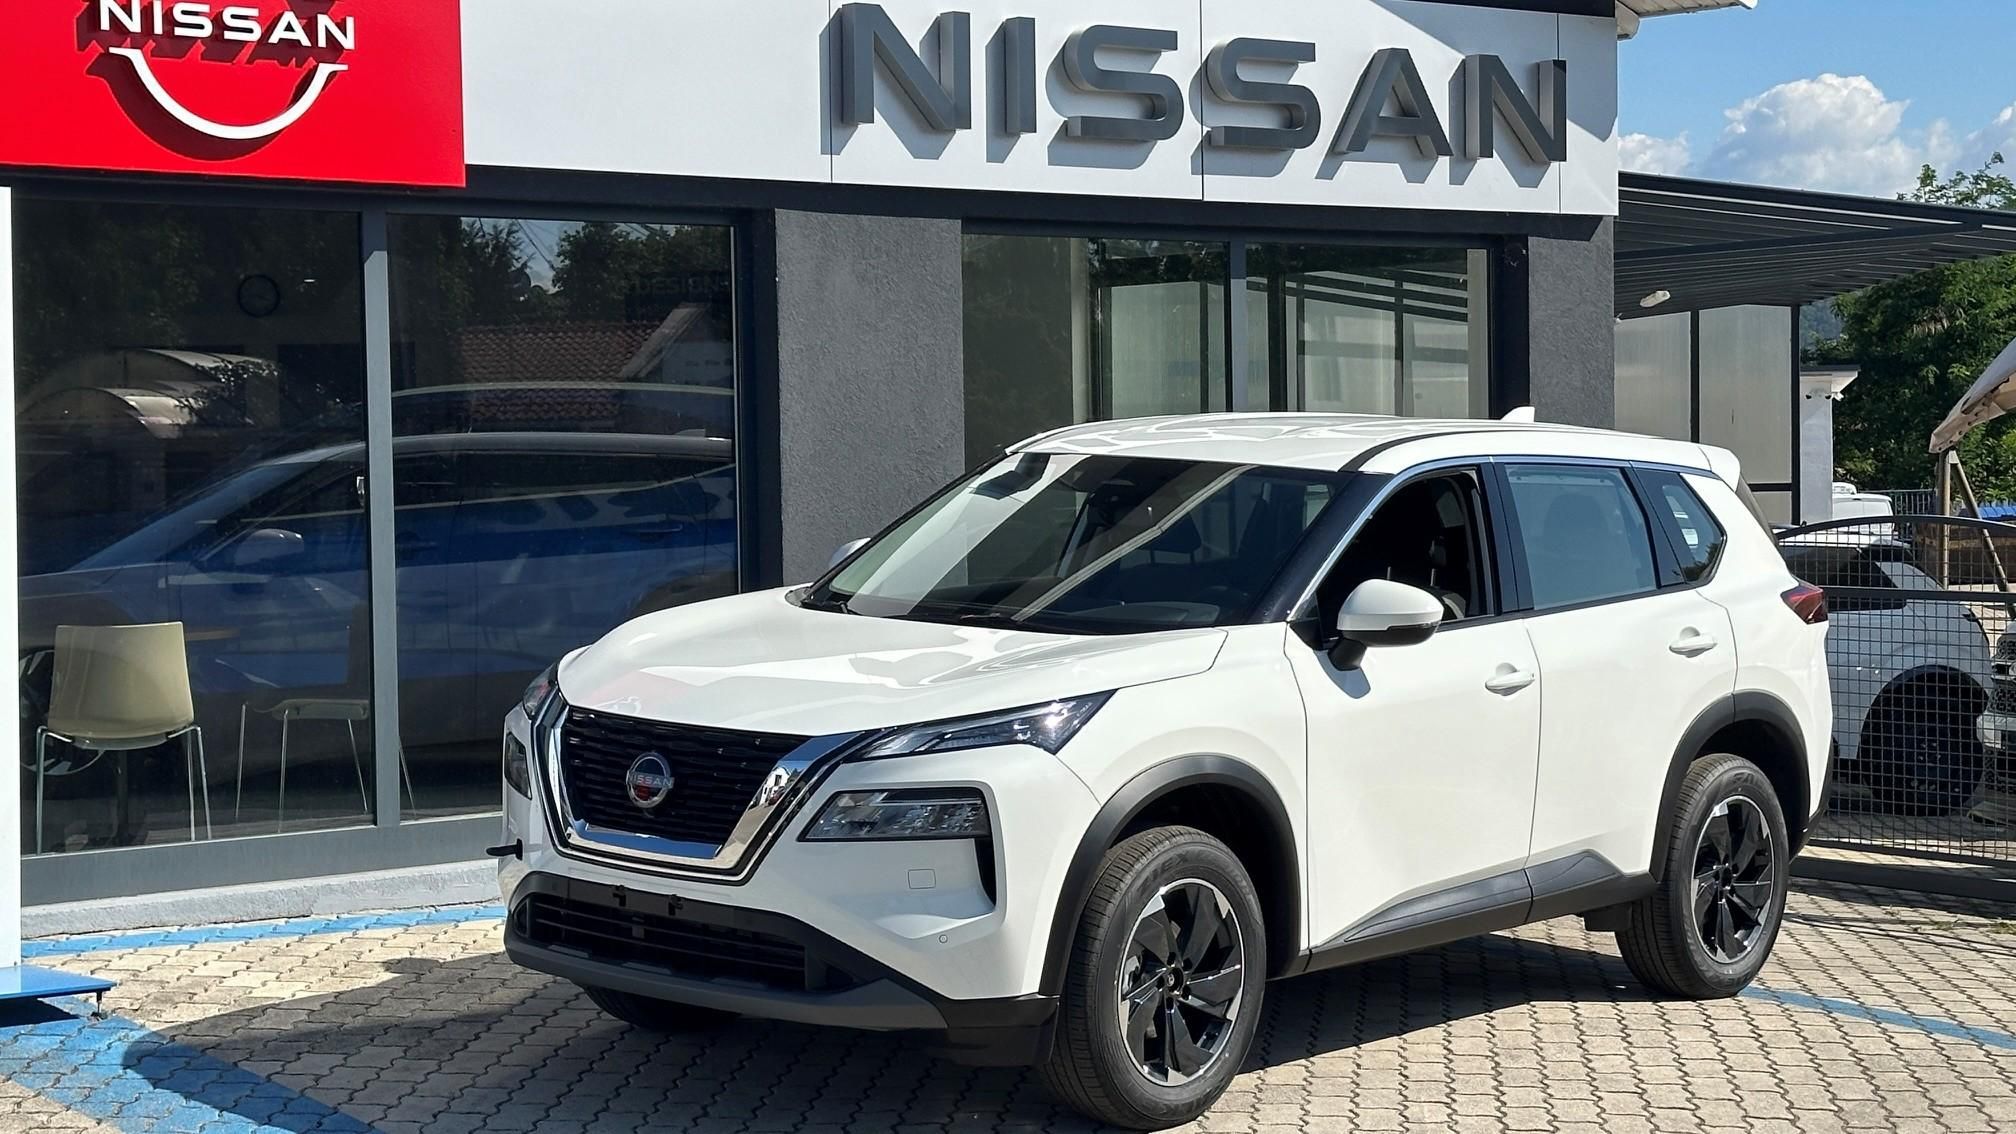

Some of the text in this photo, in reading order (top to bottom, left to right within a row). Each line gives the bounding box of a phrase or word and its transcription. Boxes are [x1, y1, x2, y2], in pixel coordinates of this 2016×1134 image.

[100, 0, 355, 50] NISSAN
[842, 2, 1566, 162] NISSAN
[630, 774, 673, 787] NISSAN
